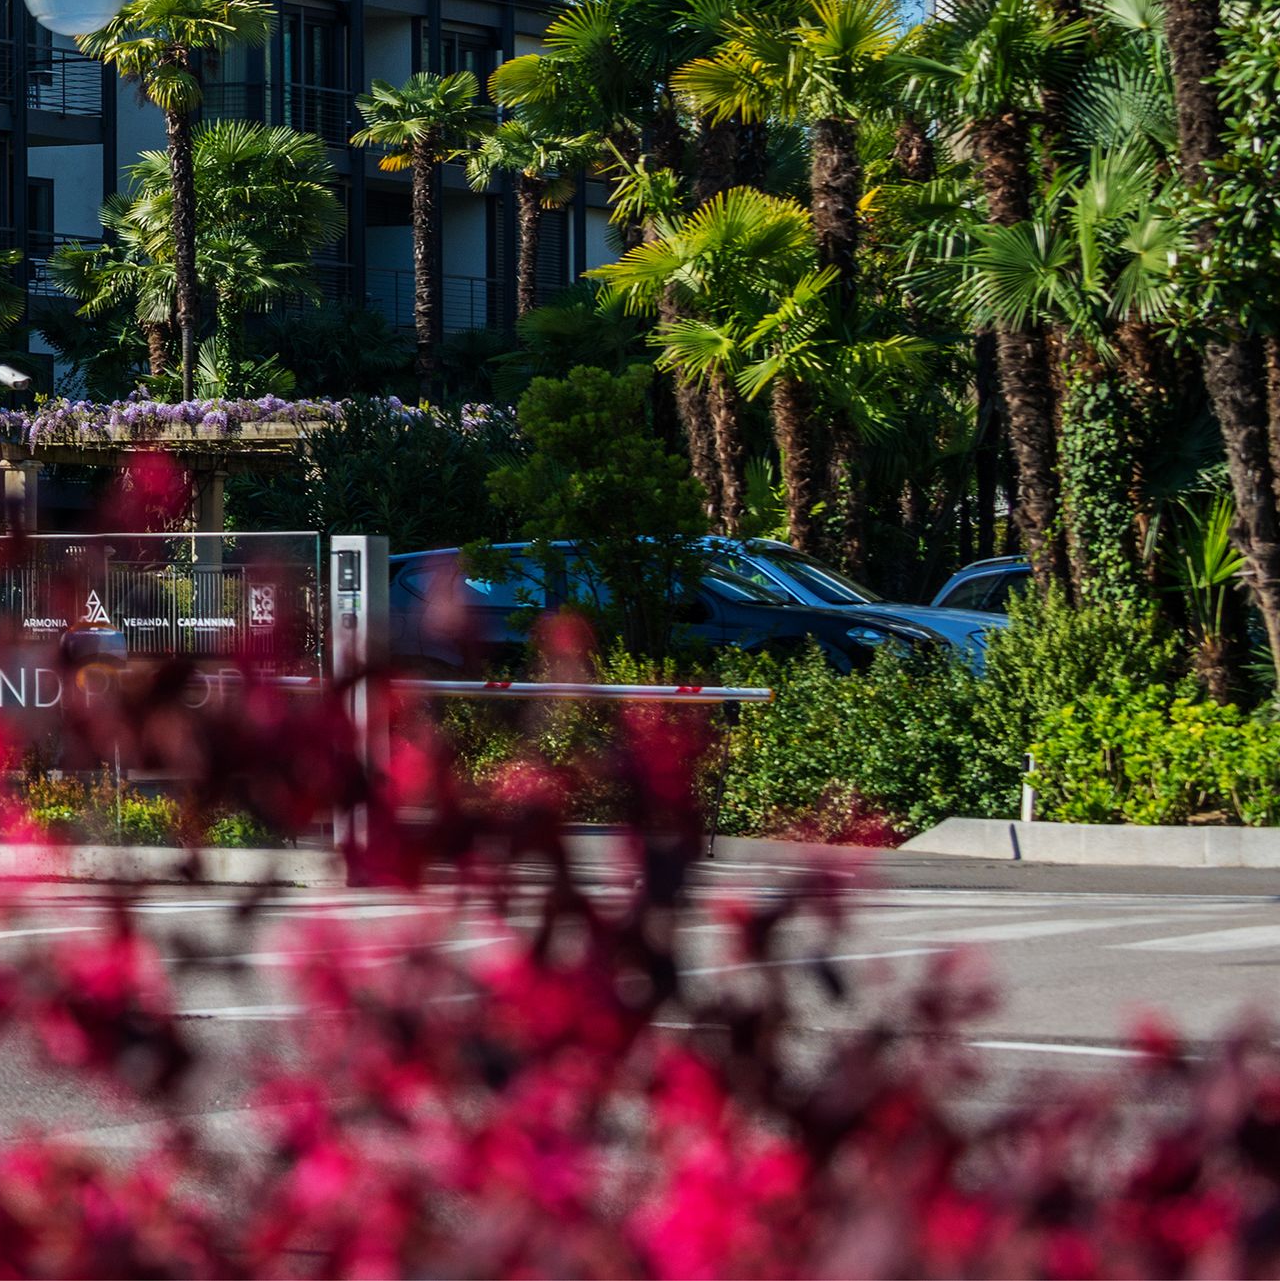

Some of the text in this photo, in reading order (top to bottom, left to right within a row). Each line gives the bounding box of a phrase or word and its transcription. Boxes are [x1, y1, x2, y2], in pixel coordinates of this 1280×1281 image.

[23, 617, 68, 628] ARMONIA
[122, 617, 169, 627] VERANDA
[177, 617, 236, 627] CAPANNINA
